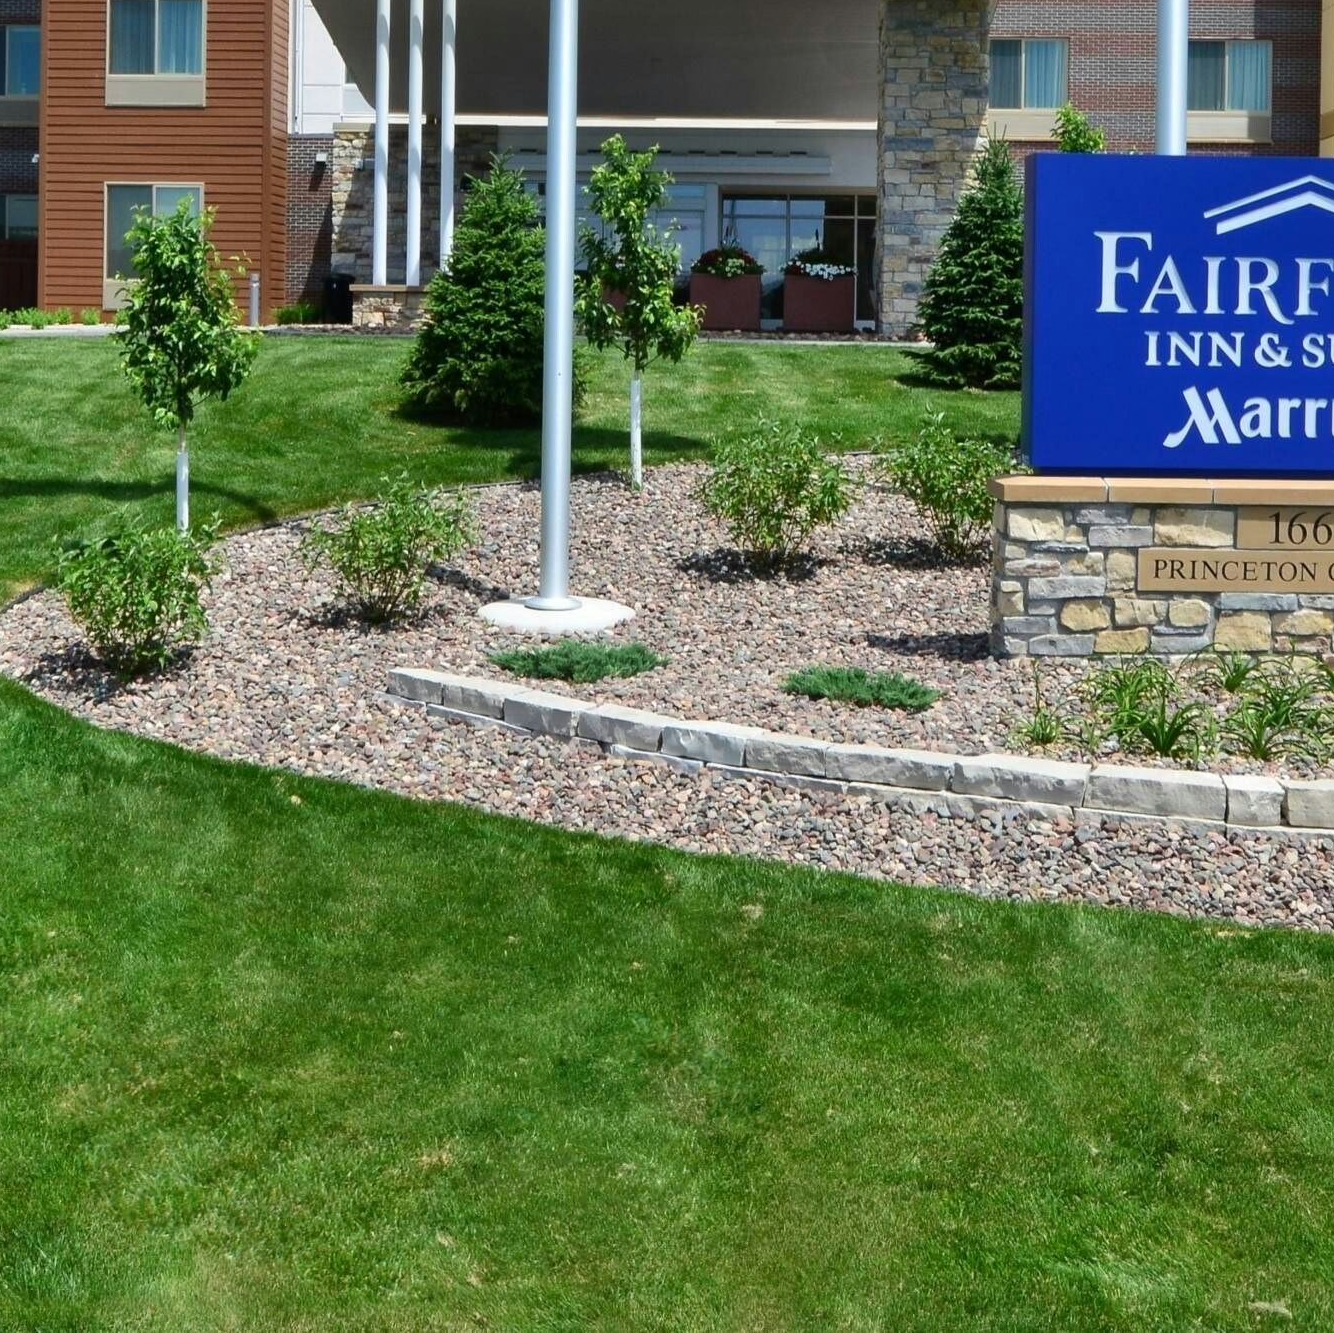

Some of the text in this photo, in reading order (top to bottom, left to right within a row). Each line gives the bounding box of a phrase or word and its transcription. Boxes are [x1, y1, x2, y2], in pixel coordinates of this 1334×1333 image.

[1143, 330, 1246, 367] INN
[1253, 331, 1294, 368] &
[1152, 558, 1318, 582] PRINCETON
